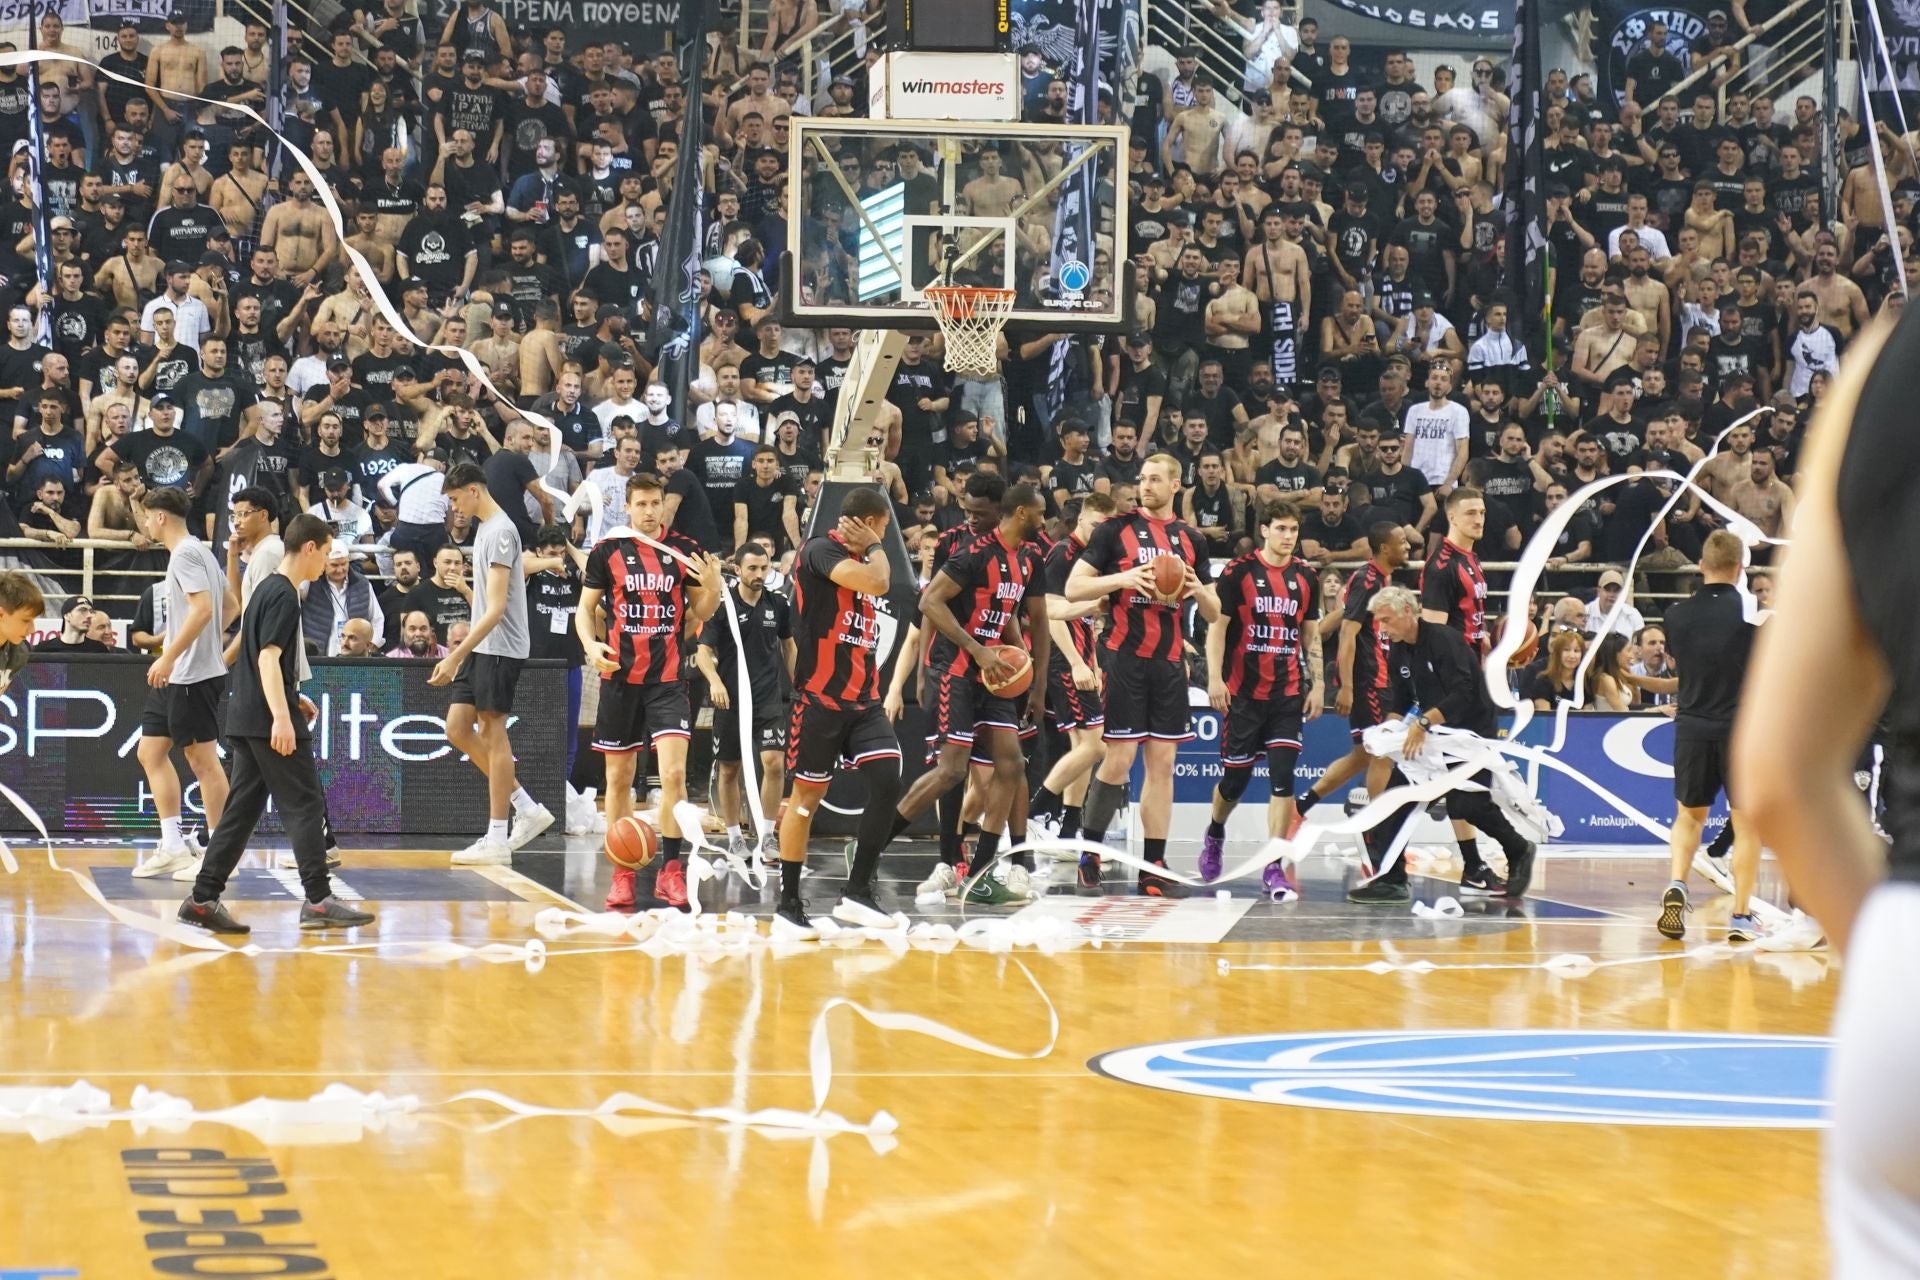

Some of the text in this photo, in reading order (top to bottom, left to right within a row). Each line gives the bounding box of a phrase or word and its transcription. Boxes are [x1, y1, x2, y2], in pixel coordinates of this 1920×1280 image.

[0, 2, 69, 21] SDORF
[583, 1, 681, 24] ΠΟΥΘΕΝΑ
[95, 36, 120, 51] 104
[902, 78, 1004, 95] winmasters
[1043, 300, 1082, 308] EUROPE
[1273, 338, 1297, 385] SIDE
[360, 459, 399, 477] 1926
[541, 584, 573, 596] PAK
[624, 573, 675, 593] BILBAO
[619, 603, 676, 619] surne
[1255, 596, 1299, 617] BILBAO
[1247, 624, 1299, 641] surne
[1246, 643, 1297, 655] azulmarino
